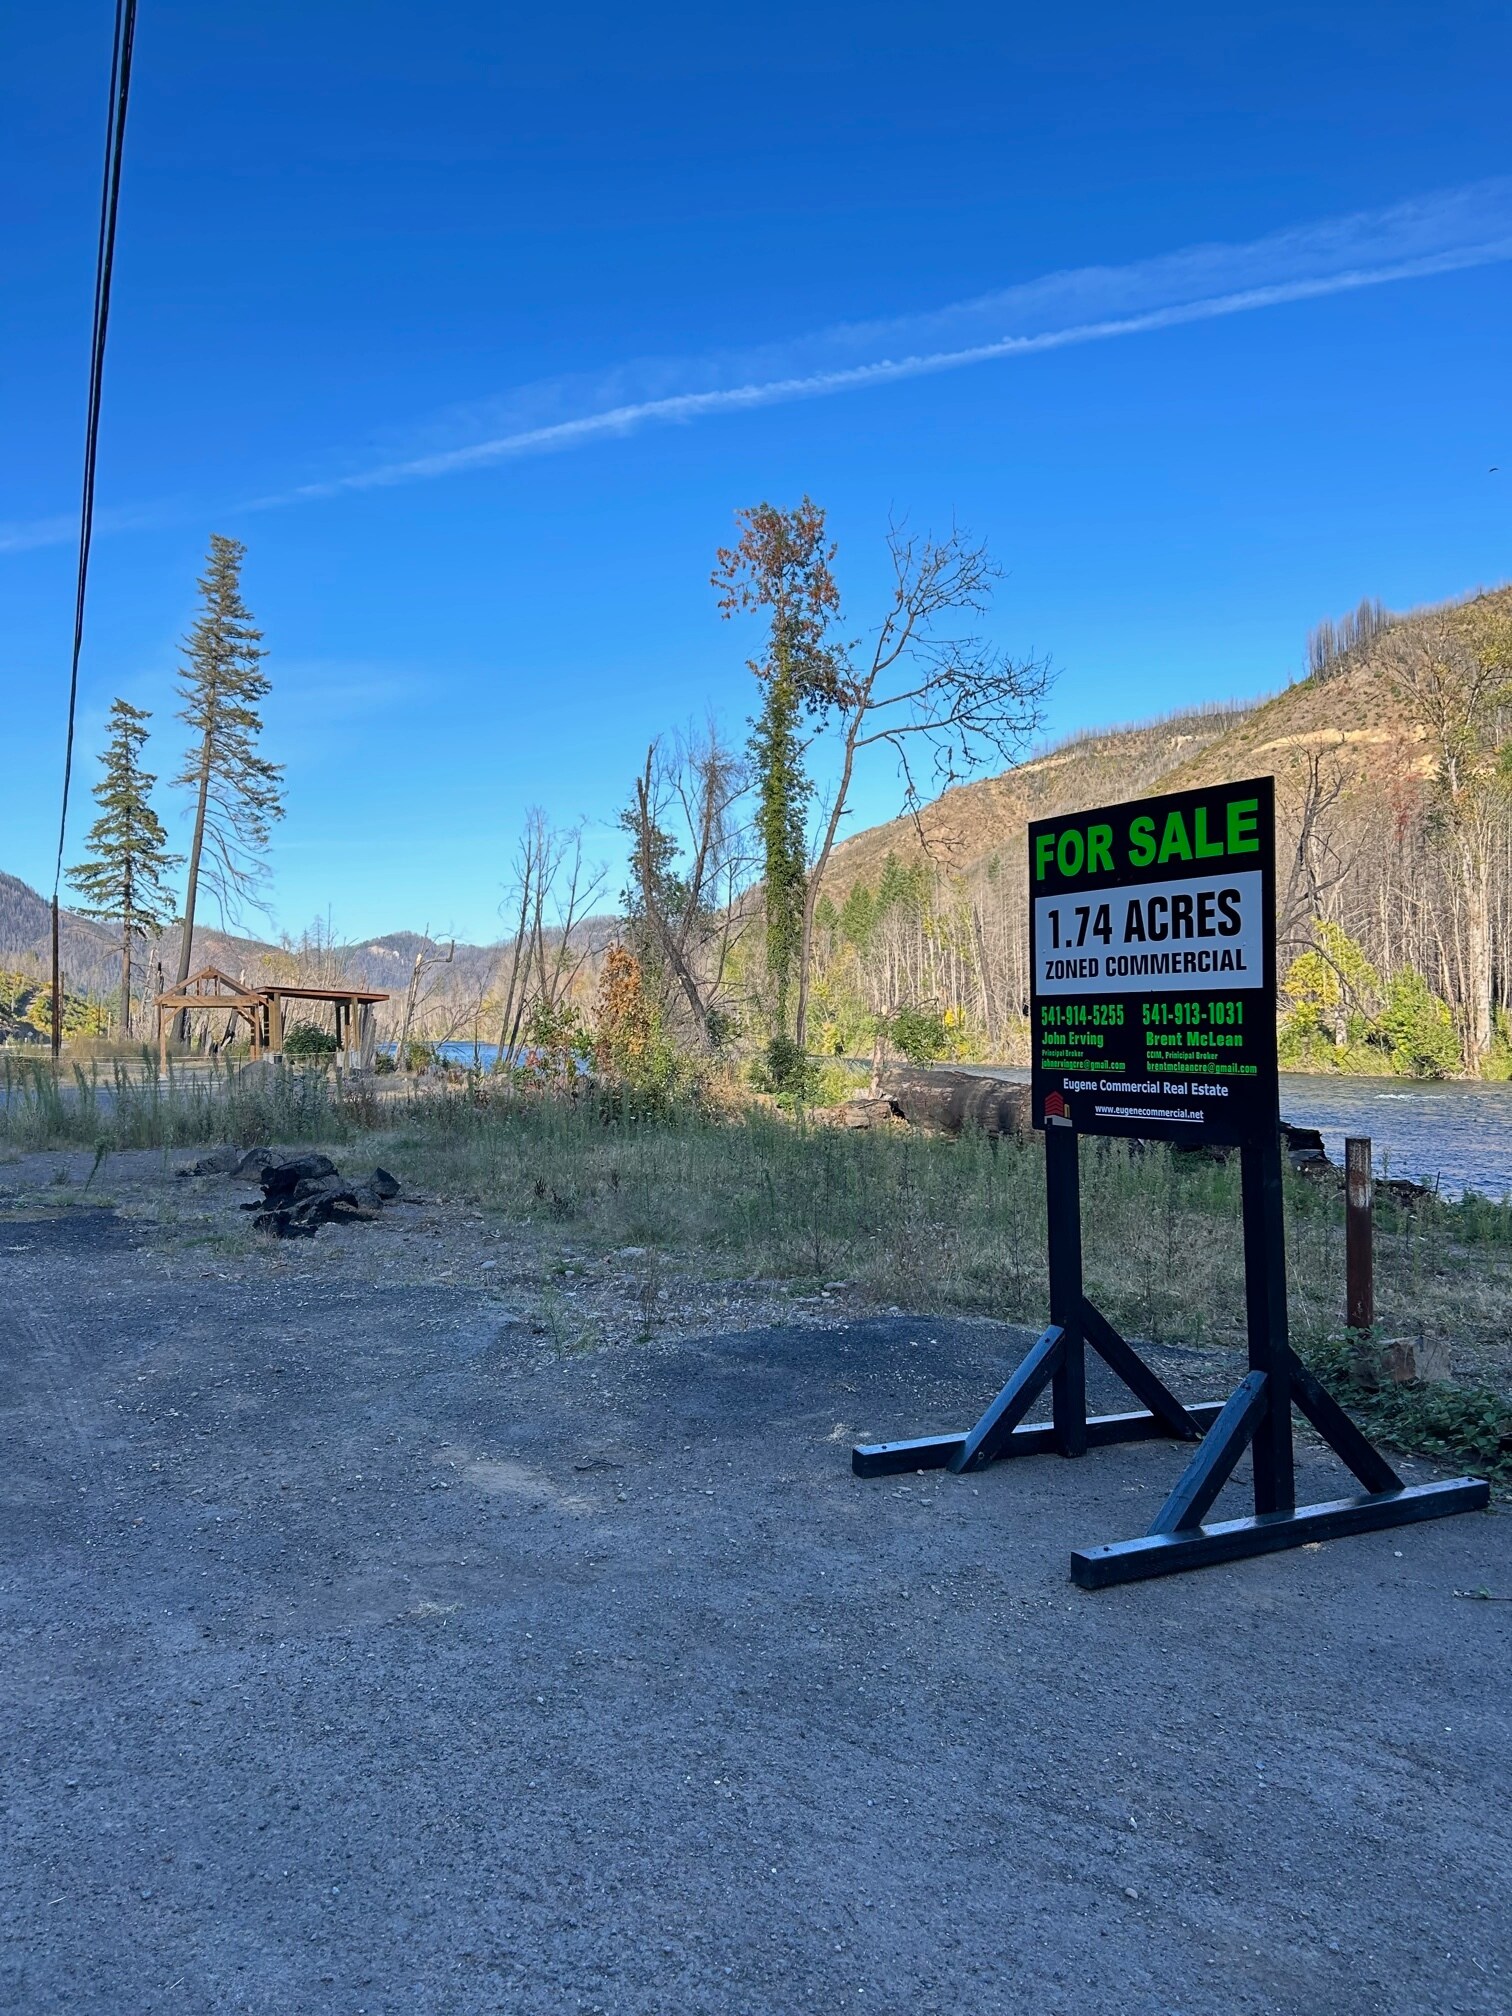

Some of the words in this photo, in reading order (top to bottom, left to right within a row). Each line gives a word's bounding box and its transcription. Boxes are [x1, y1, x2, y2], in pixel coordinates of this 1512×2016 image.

[1036, 824, 1115, 881] FOR
[1128, 798, 1260, 867] SALE
[1048, 903, 1113, 949] 1.74
[1123, 888, 1242, 943] ACRES
[1045, 957, 1099, 980] ZONED
[1105, 949, 1247, 977] COMMERCIAL
[1041, 1004, 1124, 1026] 541-914-5255
[1142, 1001, 1243, 1025] 541-913-1031
[1041, 1031, 1066, 1045] John
[1068, 1031, 1104, 1049] Erving
[1146, 1031, 1183, 1046] Brent
[1186, 1031, 1243, 1047] McLean
[1195, 1051, 1218, 1060] Broker
[1063, 1077, 1098, 1093] Eugene
[1099, 1079, 1160, 1094] Commercial
[1163, 1081, 1188, 1095] Real
[1191, 1082, 1229, 1097] Estate
[1095, 1105, 1204, 1119] www.eugenecommercial.net
